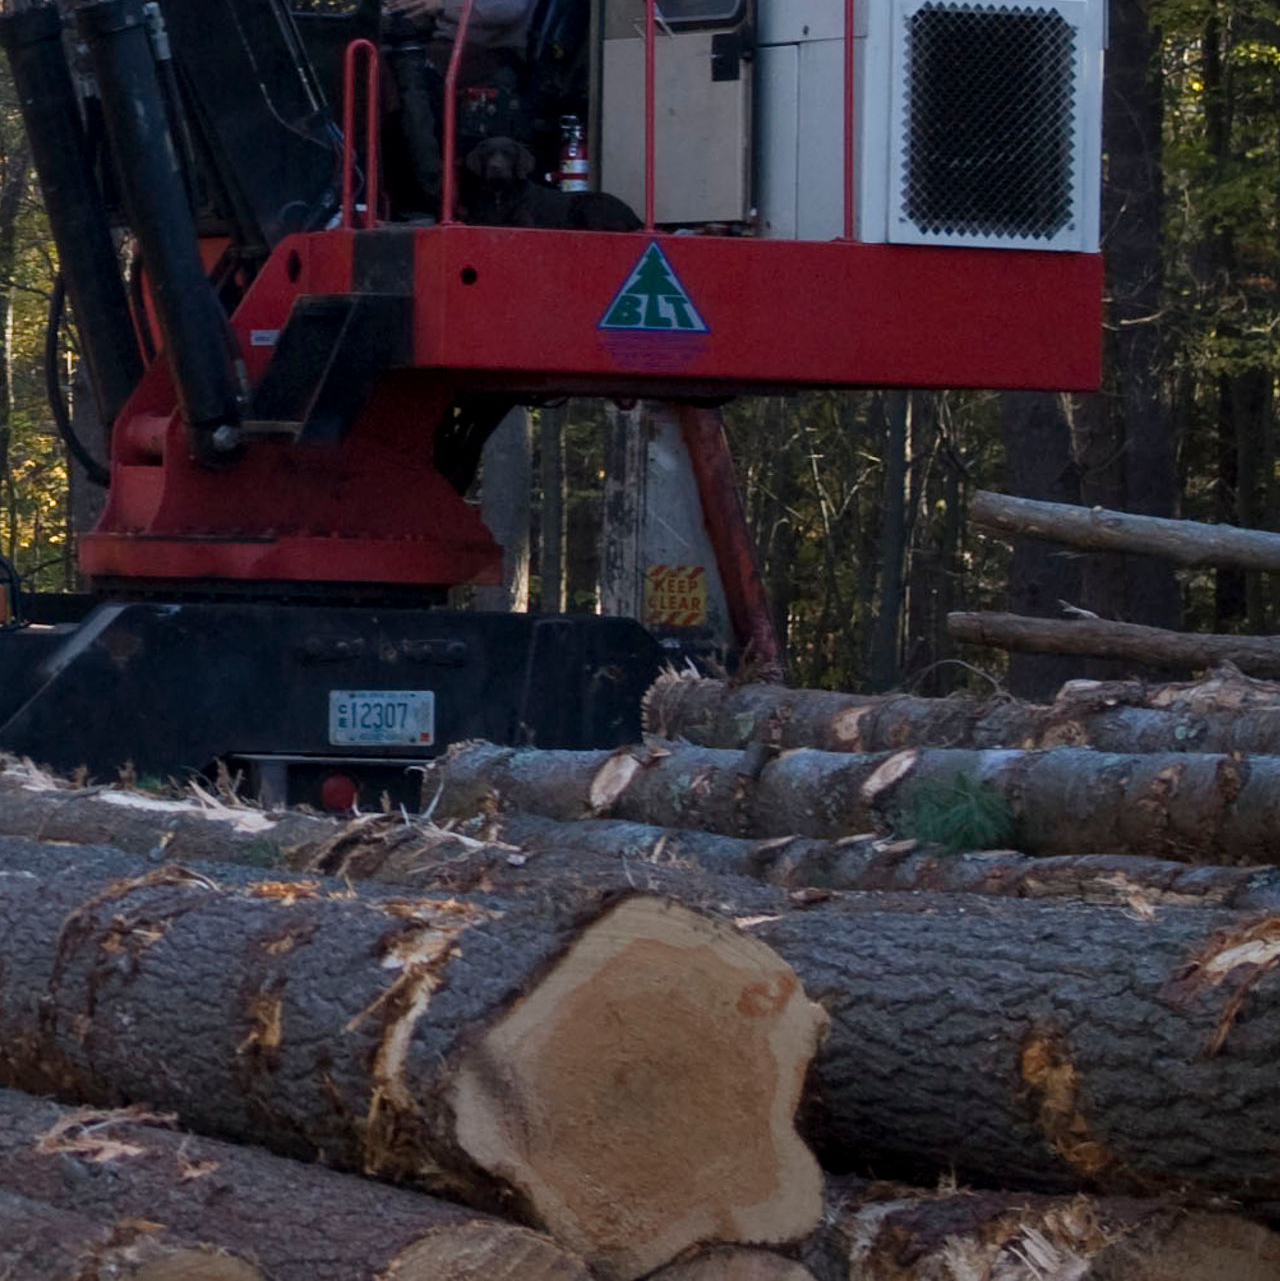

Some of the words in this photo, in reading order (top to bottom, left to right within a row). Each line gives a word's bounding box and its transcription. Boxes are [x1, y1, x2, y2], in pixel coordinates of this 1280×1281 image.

[605, 295, 695, 329] BLT
[653, 578, 698, 594] KEEP
[648, 596, 701, 611] CLEAR
[352, 702, 408, 729] 12307
